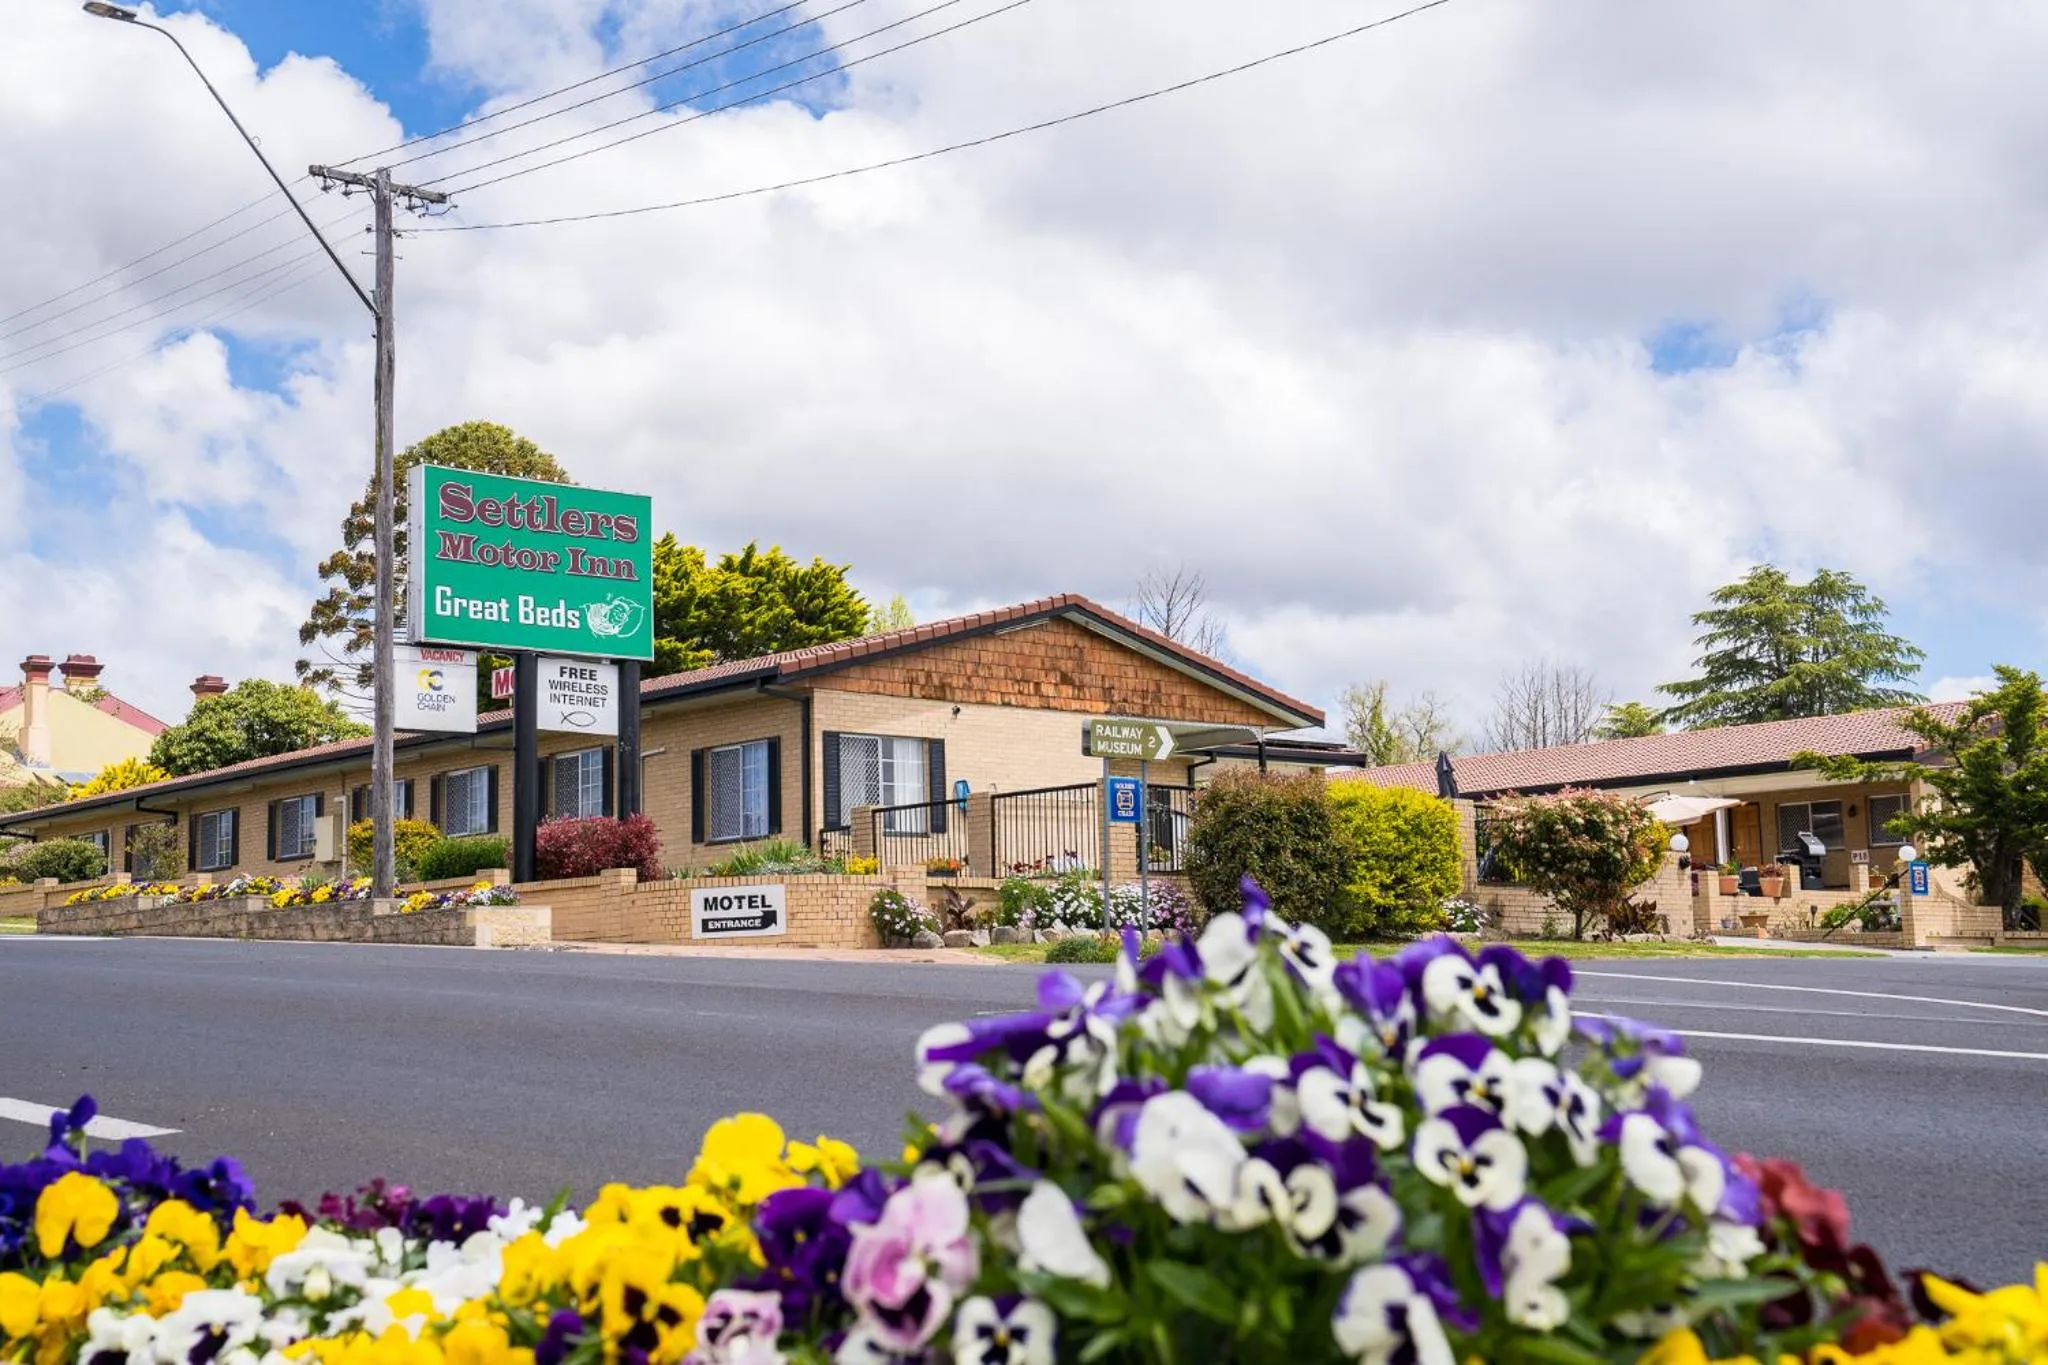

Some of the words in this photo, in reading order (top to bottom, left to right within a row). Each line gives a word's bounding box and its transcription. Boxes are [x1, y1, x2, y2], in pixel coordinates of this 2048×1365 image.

[438, 481, 639, 543] Settlers
[435, 529, 560, 573] Motor
[565, 546, 640, 582] Inn
[435, 585, 510, 623] Great
[518, 594, 581, 630] Beds
[420, 648, 465, 662] VACANCY
[559, 665, 598, 681] FREE
[494, 669, 516, 697] M
[548, 679, 609, 696] WIRELESS
[416, 693, 456, 704] GOLDEN
[549, 692, 608, 708] INTERNET
[416, 702, 446, 712] CHAIN
[1095, 724, 1144, 740] RAILWAY
[1097, 740, 1143, 756] MUSEUM
[1147, 735, 1156, 748] 2
[703, 894, 773, 912] MOTEL
[707, 917, 762, 930] ENTRANCE
